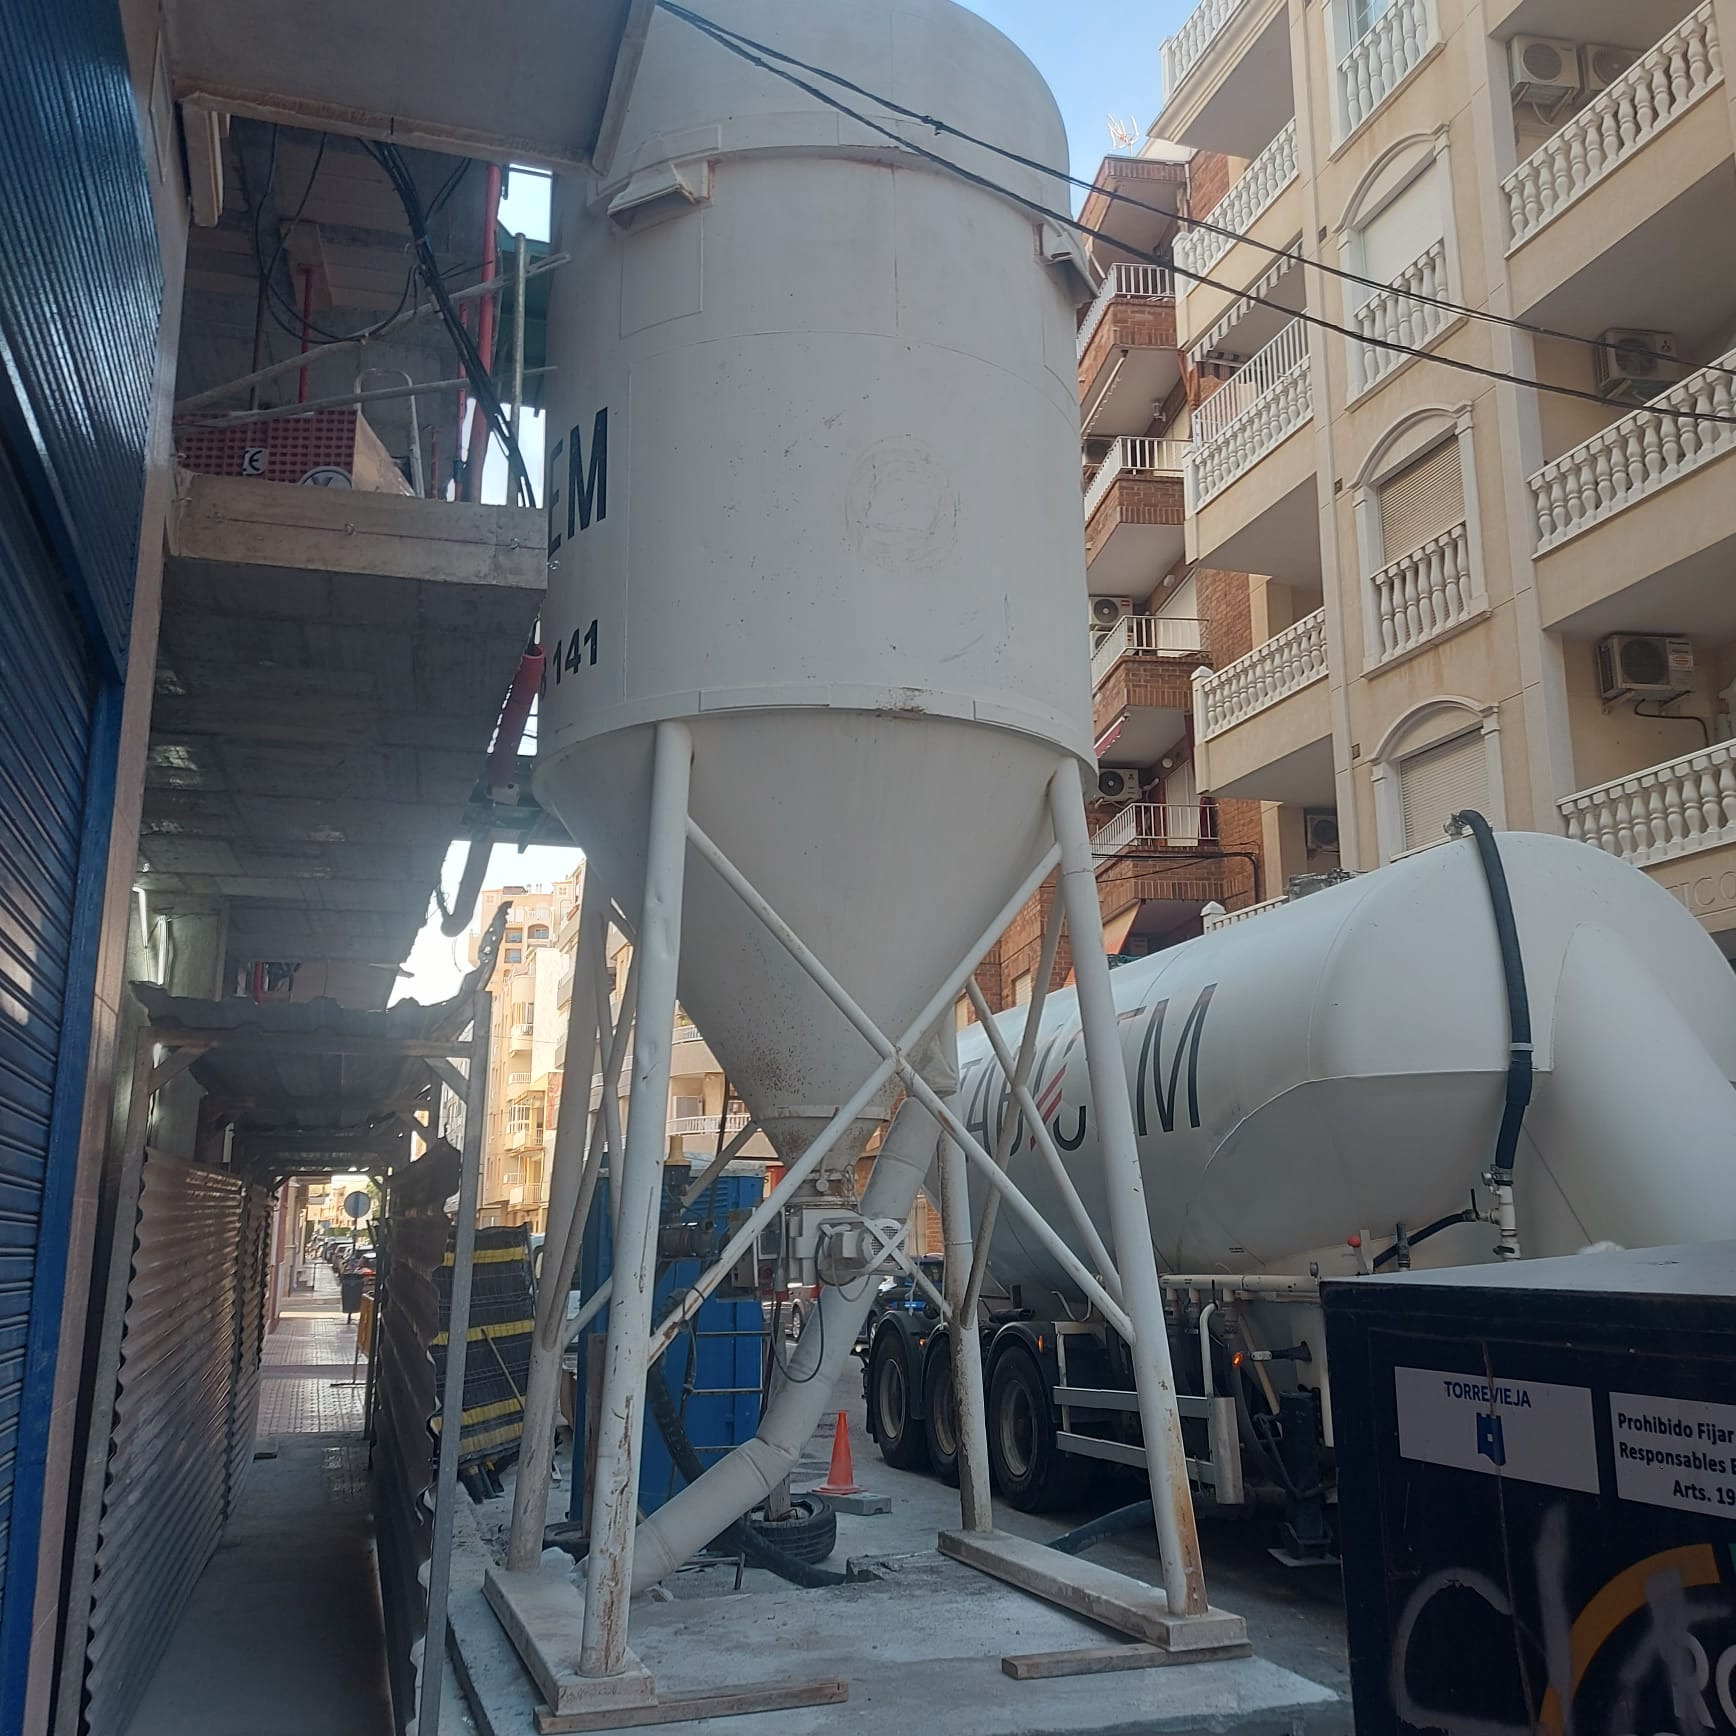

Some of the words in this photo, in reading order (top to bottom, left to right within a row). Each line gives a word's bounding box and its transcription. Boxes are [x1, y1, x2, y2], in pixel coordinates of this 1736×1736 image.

[540, 619, 599, 701] 141
[1443, 1380, 1531, 1408] TORREVIEJA
[1617, 1412, 1693, 1438] Prohibido
[1697, 1422, 1734, 1446] Fijar
[1619, 1441, 1726, 1474] Responsables
[1673, 1479, 1711, 1502] Arts.
